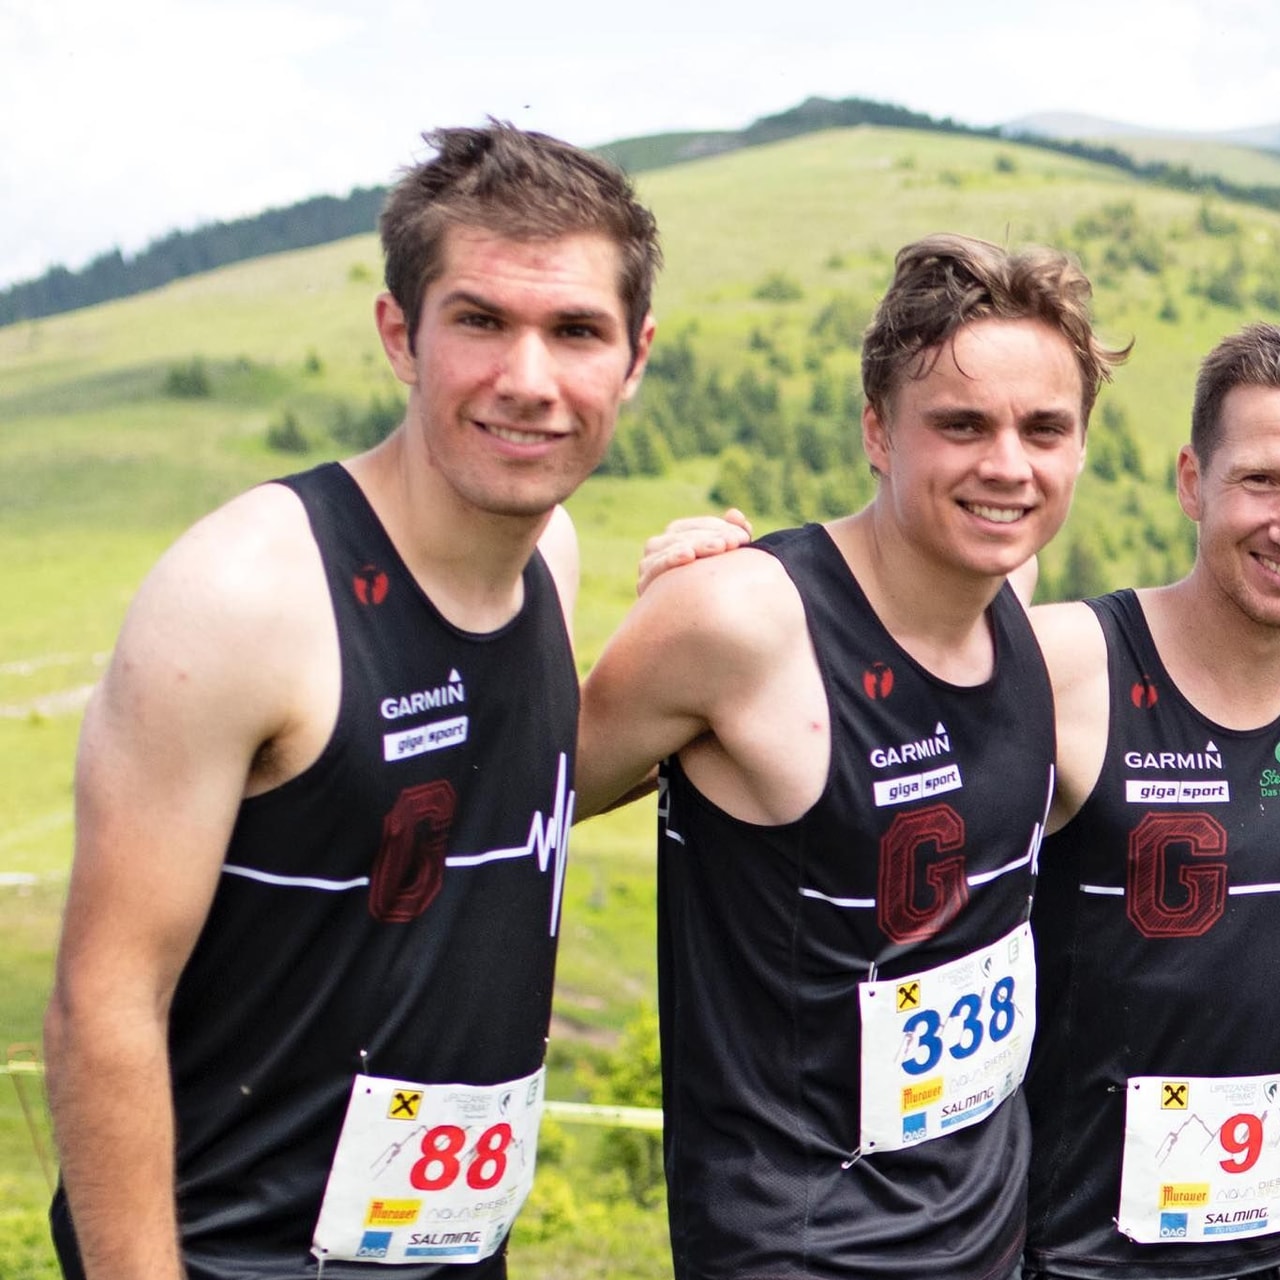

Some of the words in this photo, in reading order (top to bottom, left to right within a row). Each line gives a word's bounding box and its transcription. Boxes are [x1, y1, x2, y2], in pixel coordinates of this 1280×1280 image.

[380, 682, 464, 719] GARMIN
[870, 735, 950, 768] GARMIN
[1125, 752, 1222, 769] GARMIN
[1261, 788, 1277, 797] Das
[878, 804, 969, 944] G
[1127, 811, 1227, 938] G
[902, 976, 1015, 1075] 338
[410, 1123, 512, 1191] 88
[1220, 1113, 1263, 1173] 9
[1162, 1186, 1206, 1206] Murauer
